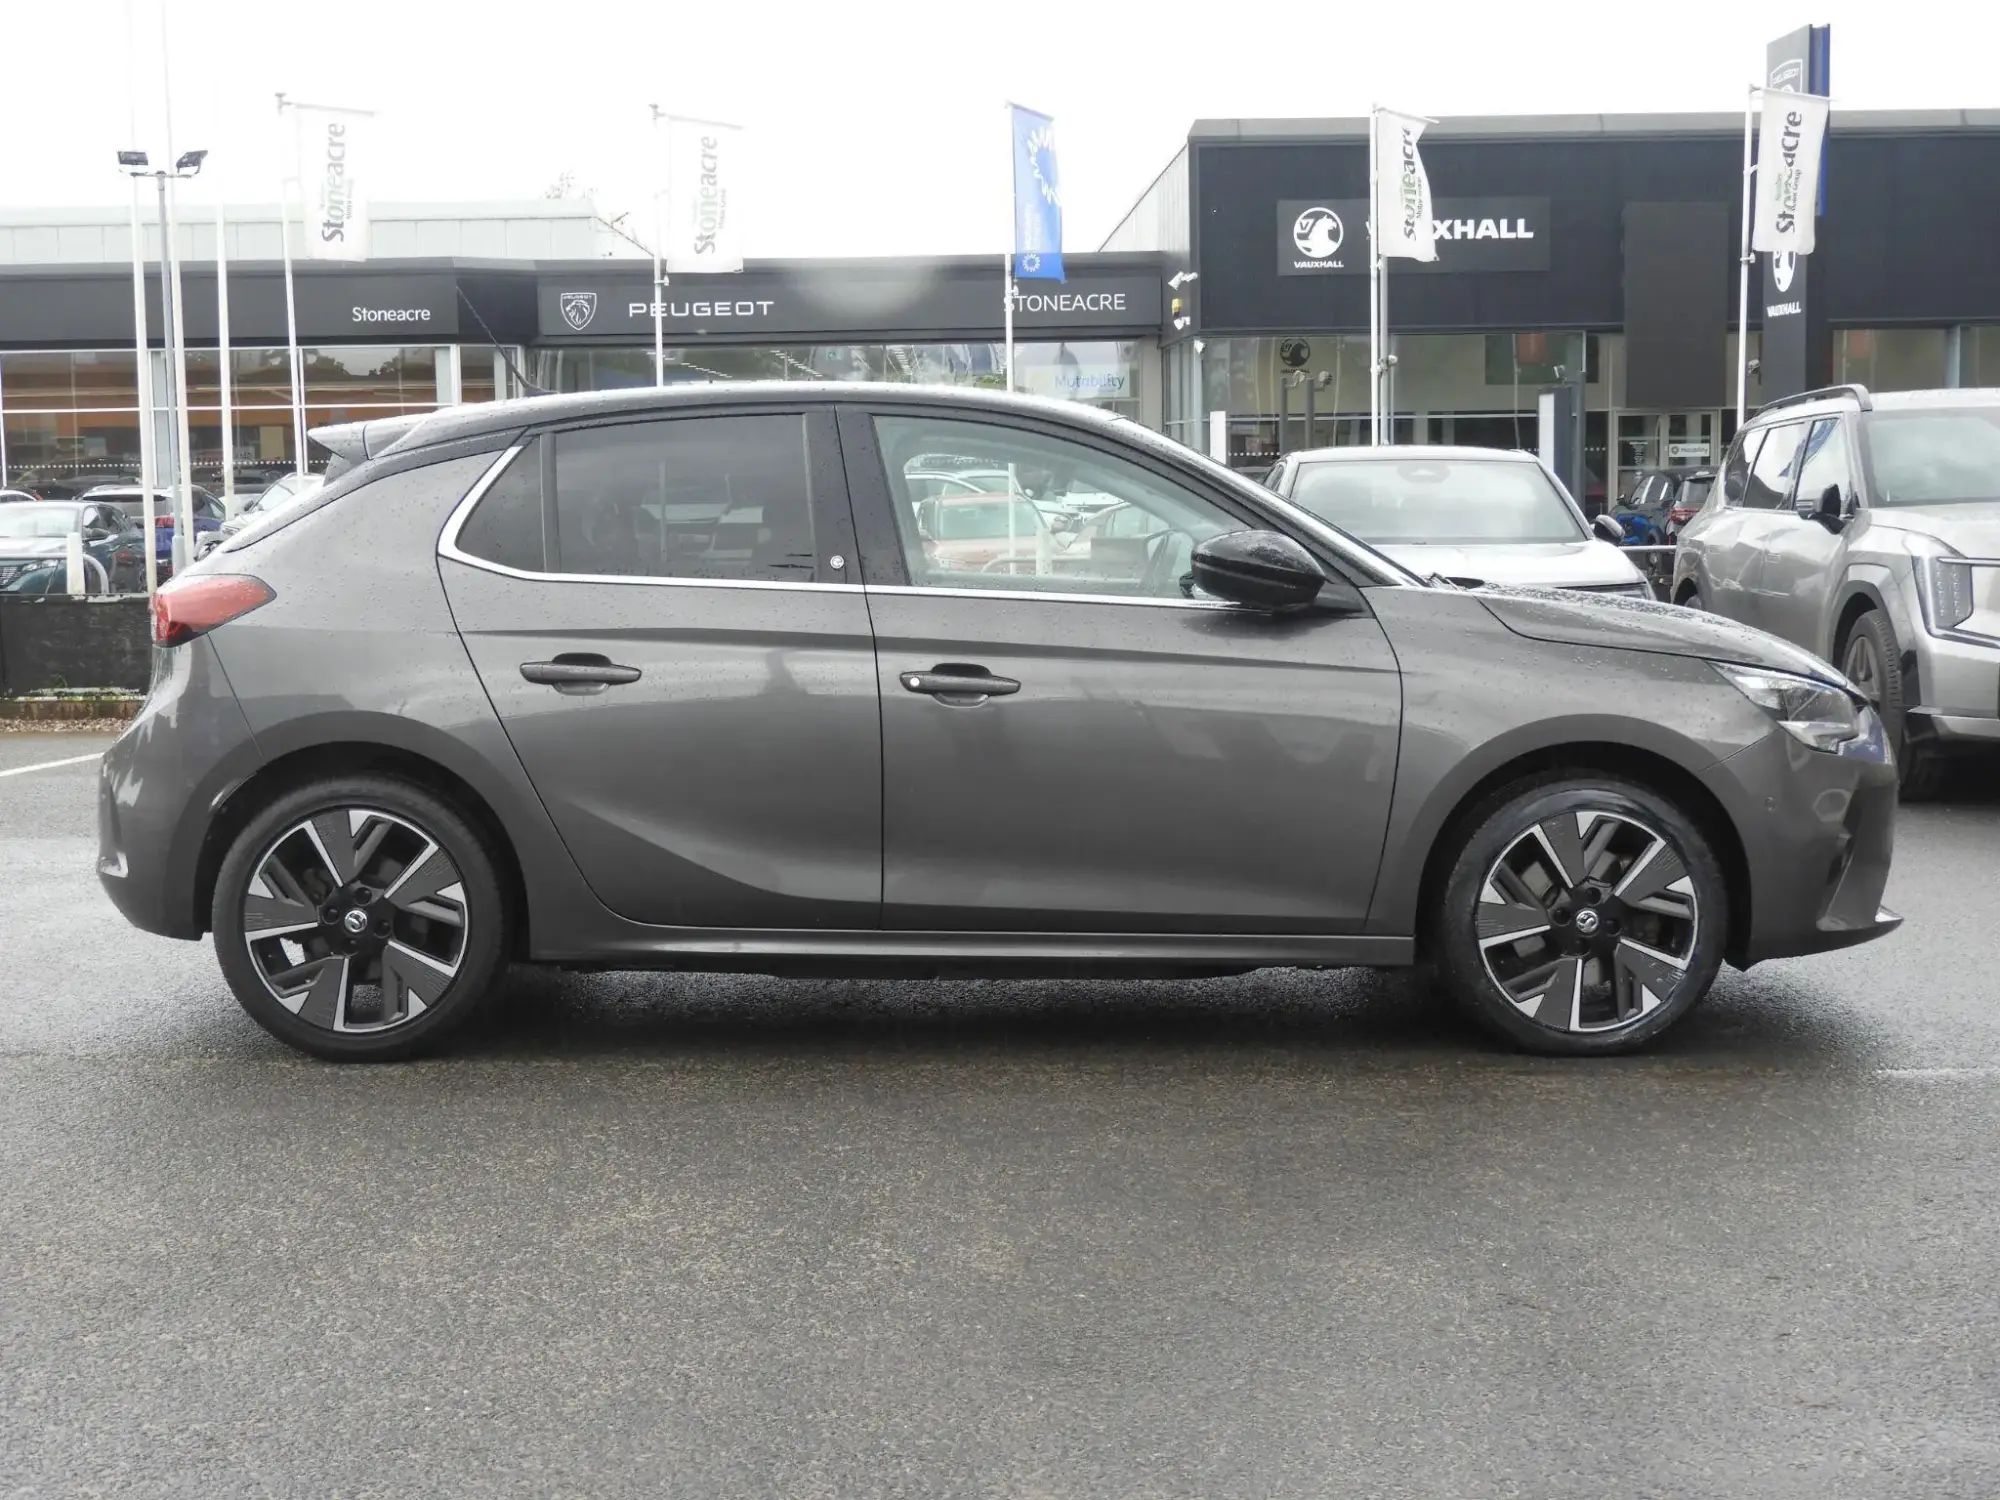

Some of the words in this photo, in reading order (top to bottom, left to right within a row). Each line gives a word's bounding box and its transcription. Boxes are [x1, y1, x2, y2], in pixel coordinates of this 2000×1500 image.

[321, 122, 346, 242] Stoneacre
[694, 136, 718, 255] Stoneacre
[1366, 218, 1534, 239] XHALL
[1293, 261, 1344, 269] VAUXHALL
[352, 306, 431, 322] Stoneacre
[629, 301, 774, 317] PEUGEOT
[1767, 301, 1802, 317] VAUXHALL
[1054, 372, 1125, 389] Motability
